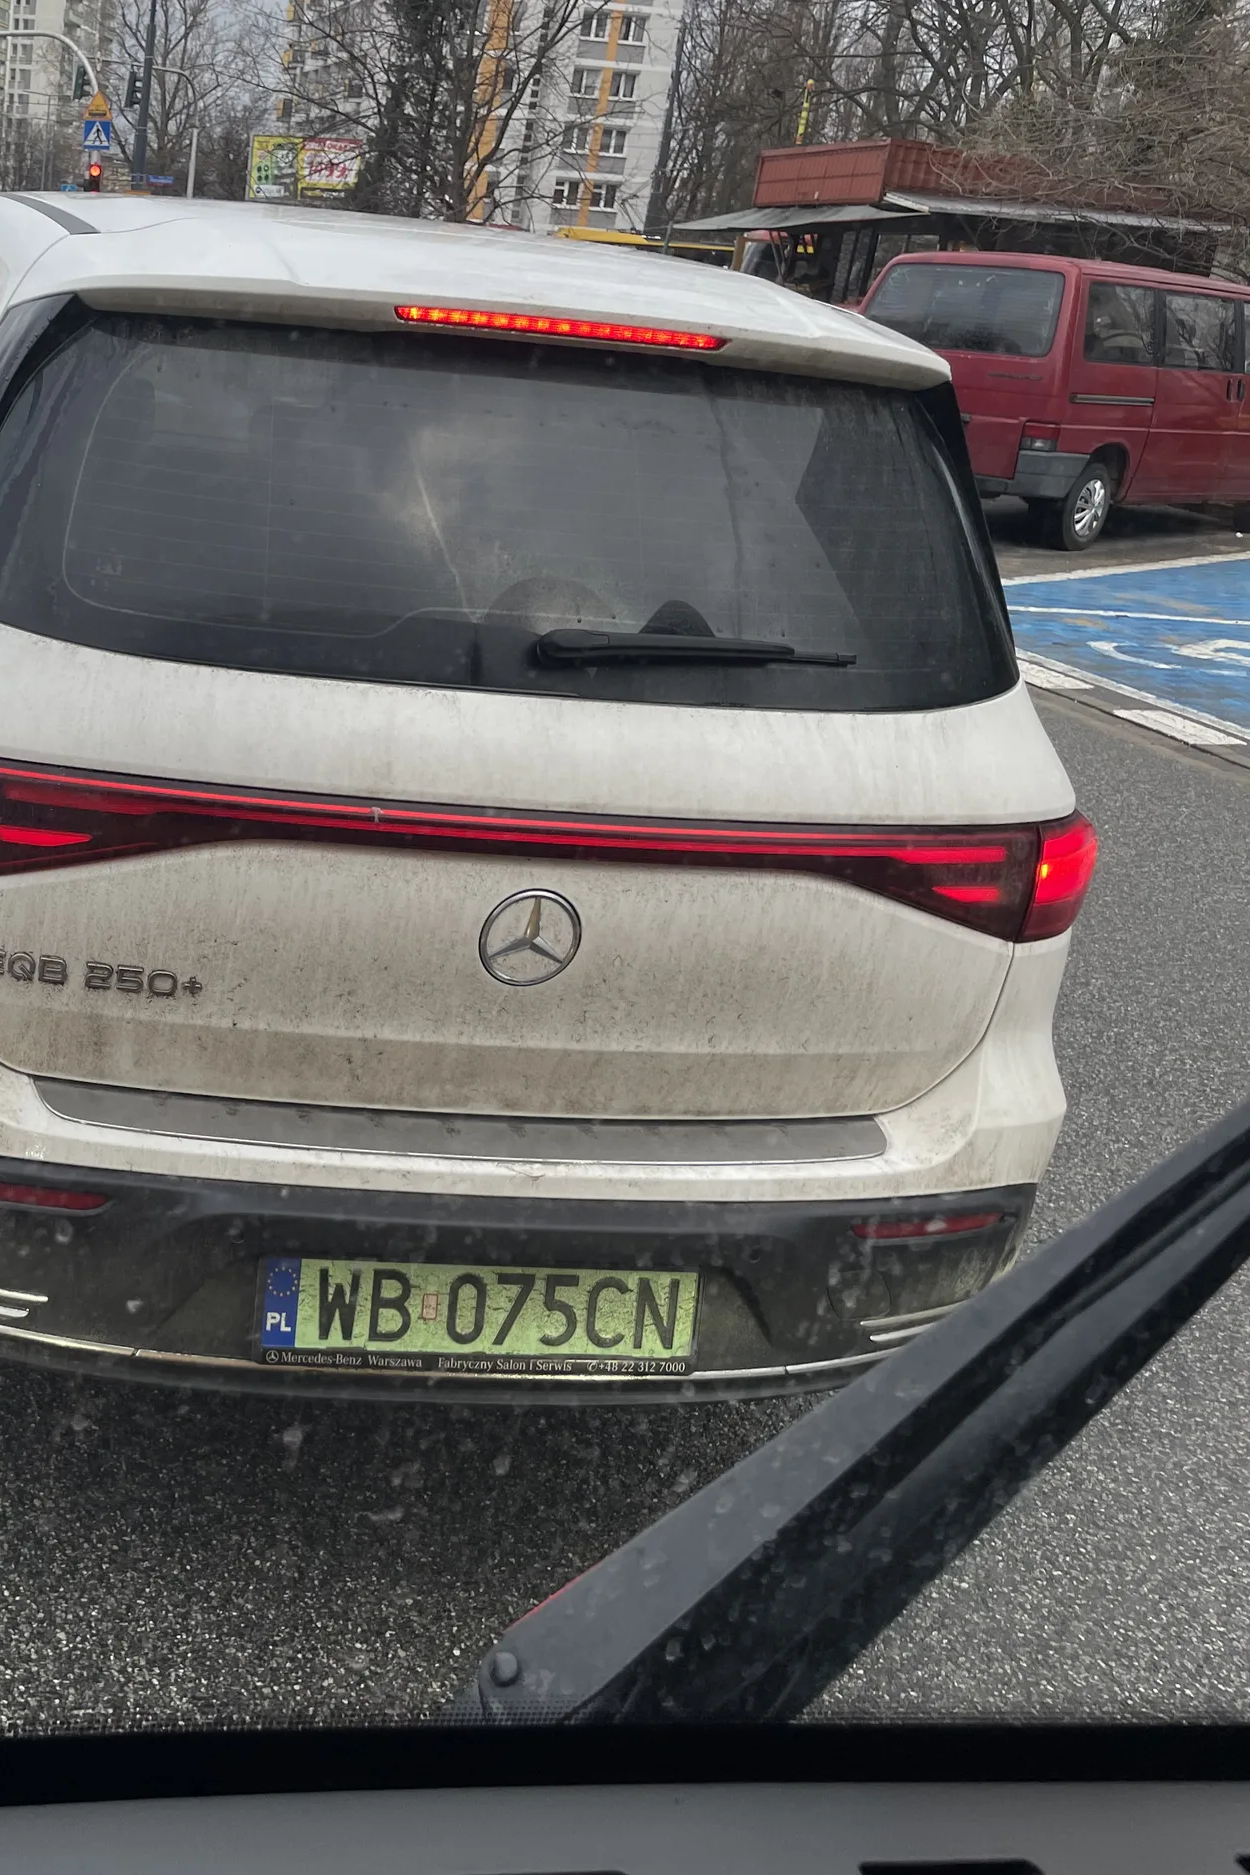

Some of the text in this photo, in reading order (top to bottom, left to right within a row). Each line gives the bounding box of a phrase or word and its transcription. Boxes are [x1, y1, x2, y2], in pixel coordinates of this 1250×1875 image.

[84, 961, 203, 996] 250+
[265, 1312, 292, 1332] PL
[318, 1267, 680, 1350] WB 075CN
[280, 1351, 362, 1366] Mercedes-Benz
[368, 1355, 423, 1368] Warszawa
[438, 1357, 493, 1373] Fabryczny
[496, 1359, 526, 1371] Salon
[536, 1360, 572, 1371] Serwis
[621, 1361, 634, 1372] 22
[637, 1361, 656, 1372] 312
[659, 1361, 685, 1373] 7000
